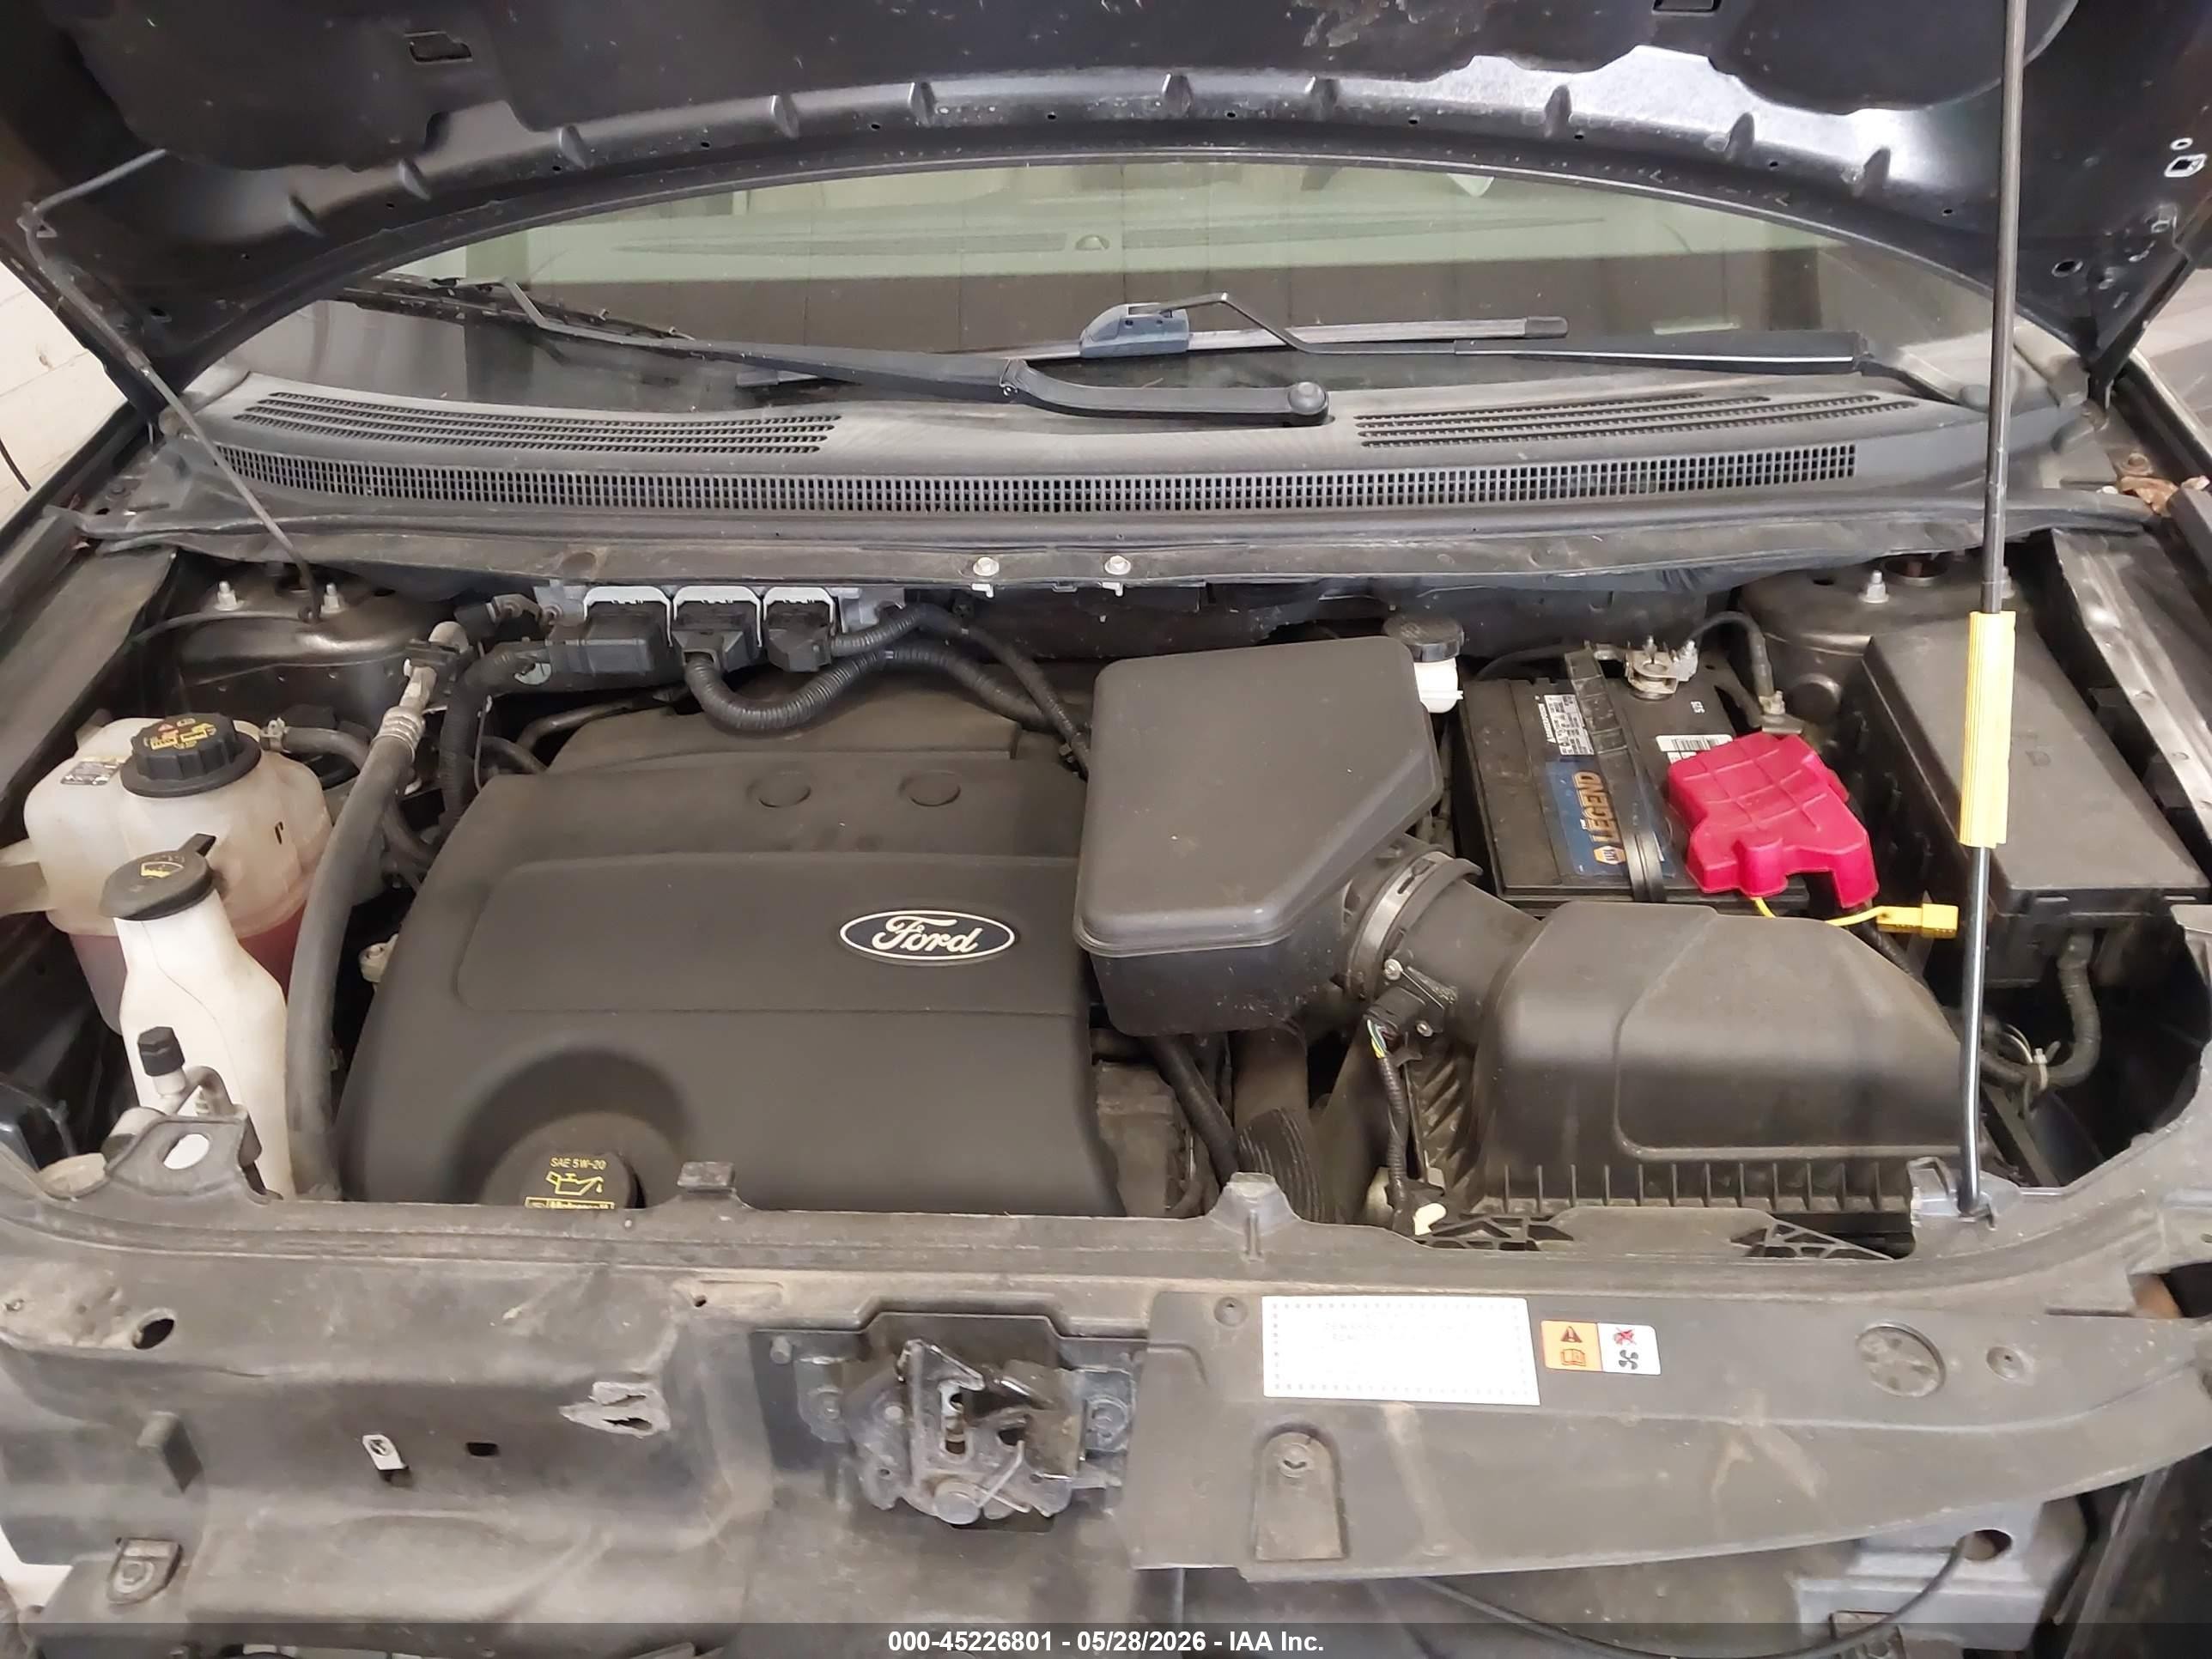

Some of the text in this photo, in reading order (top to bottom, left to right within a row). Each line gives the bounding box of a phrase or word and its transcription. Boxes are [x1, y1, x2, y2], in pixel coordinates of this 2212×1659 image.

[1572, 771, 1622, 842] LEGEND
[872, 915, 982, 952] Ford
[550, 1157, 607, 1170] SAE 5W-20
